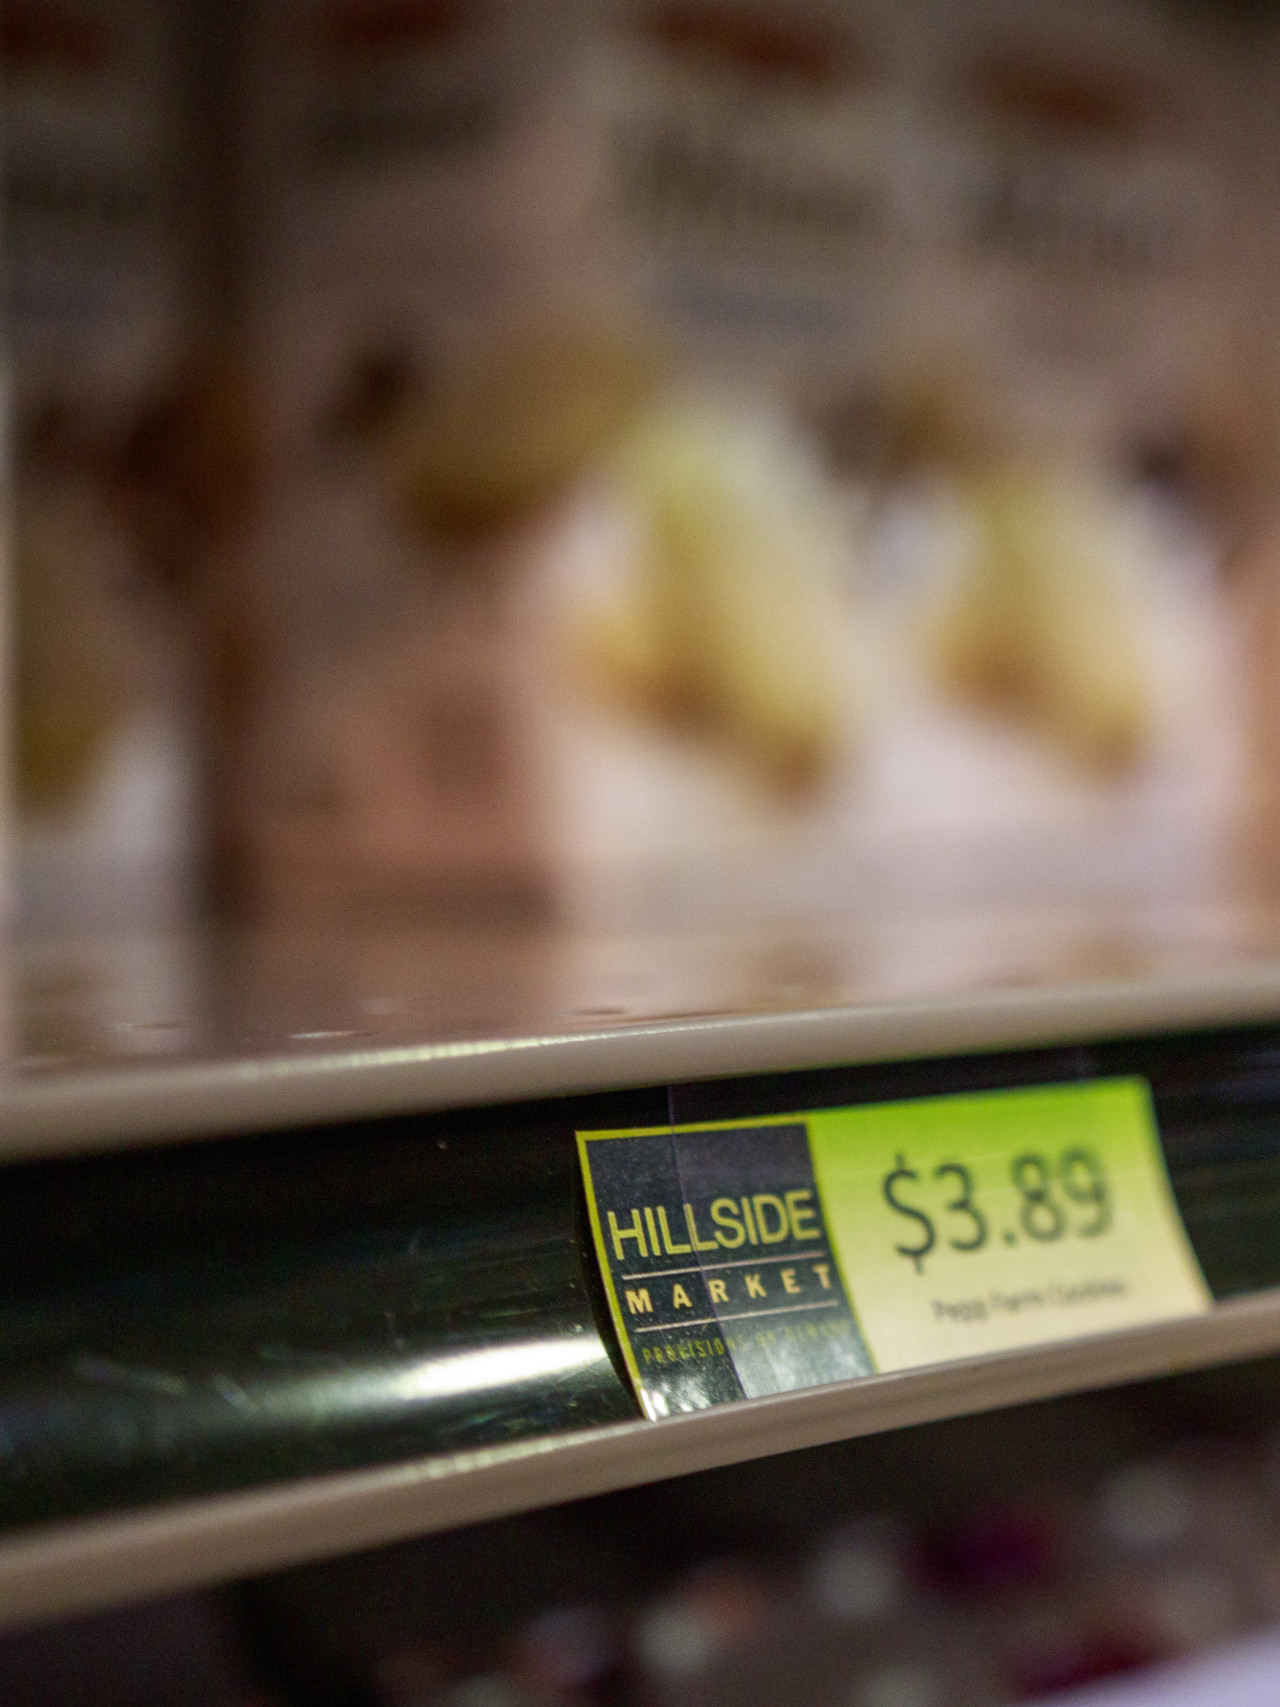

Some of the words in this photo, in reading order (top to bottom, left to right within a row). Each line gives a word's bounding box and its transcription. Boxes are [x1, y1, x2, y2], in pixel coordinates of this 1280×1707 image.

[607, 1189, 821, 1260] HILLSIDE
[882, 1148, 1112, 1275] $3.89
[625, 1263, 831, 1315] MARKET
[641, 1334, 746, 1365] PROVISIONS
